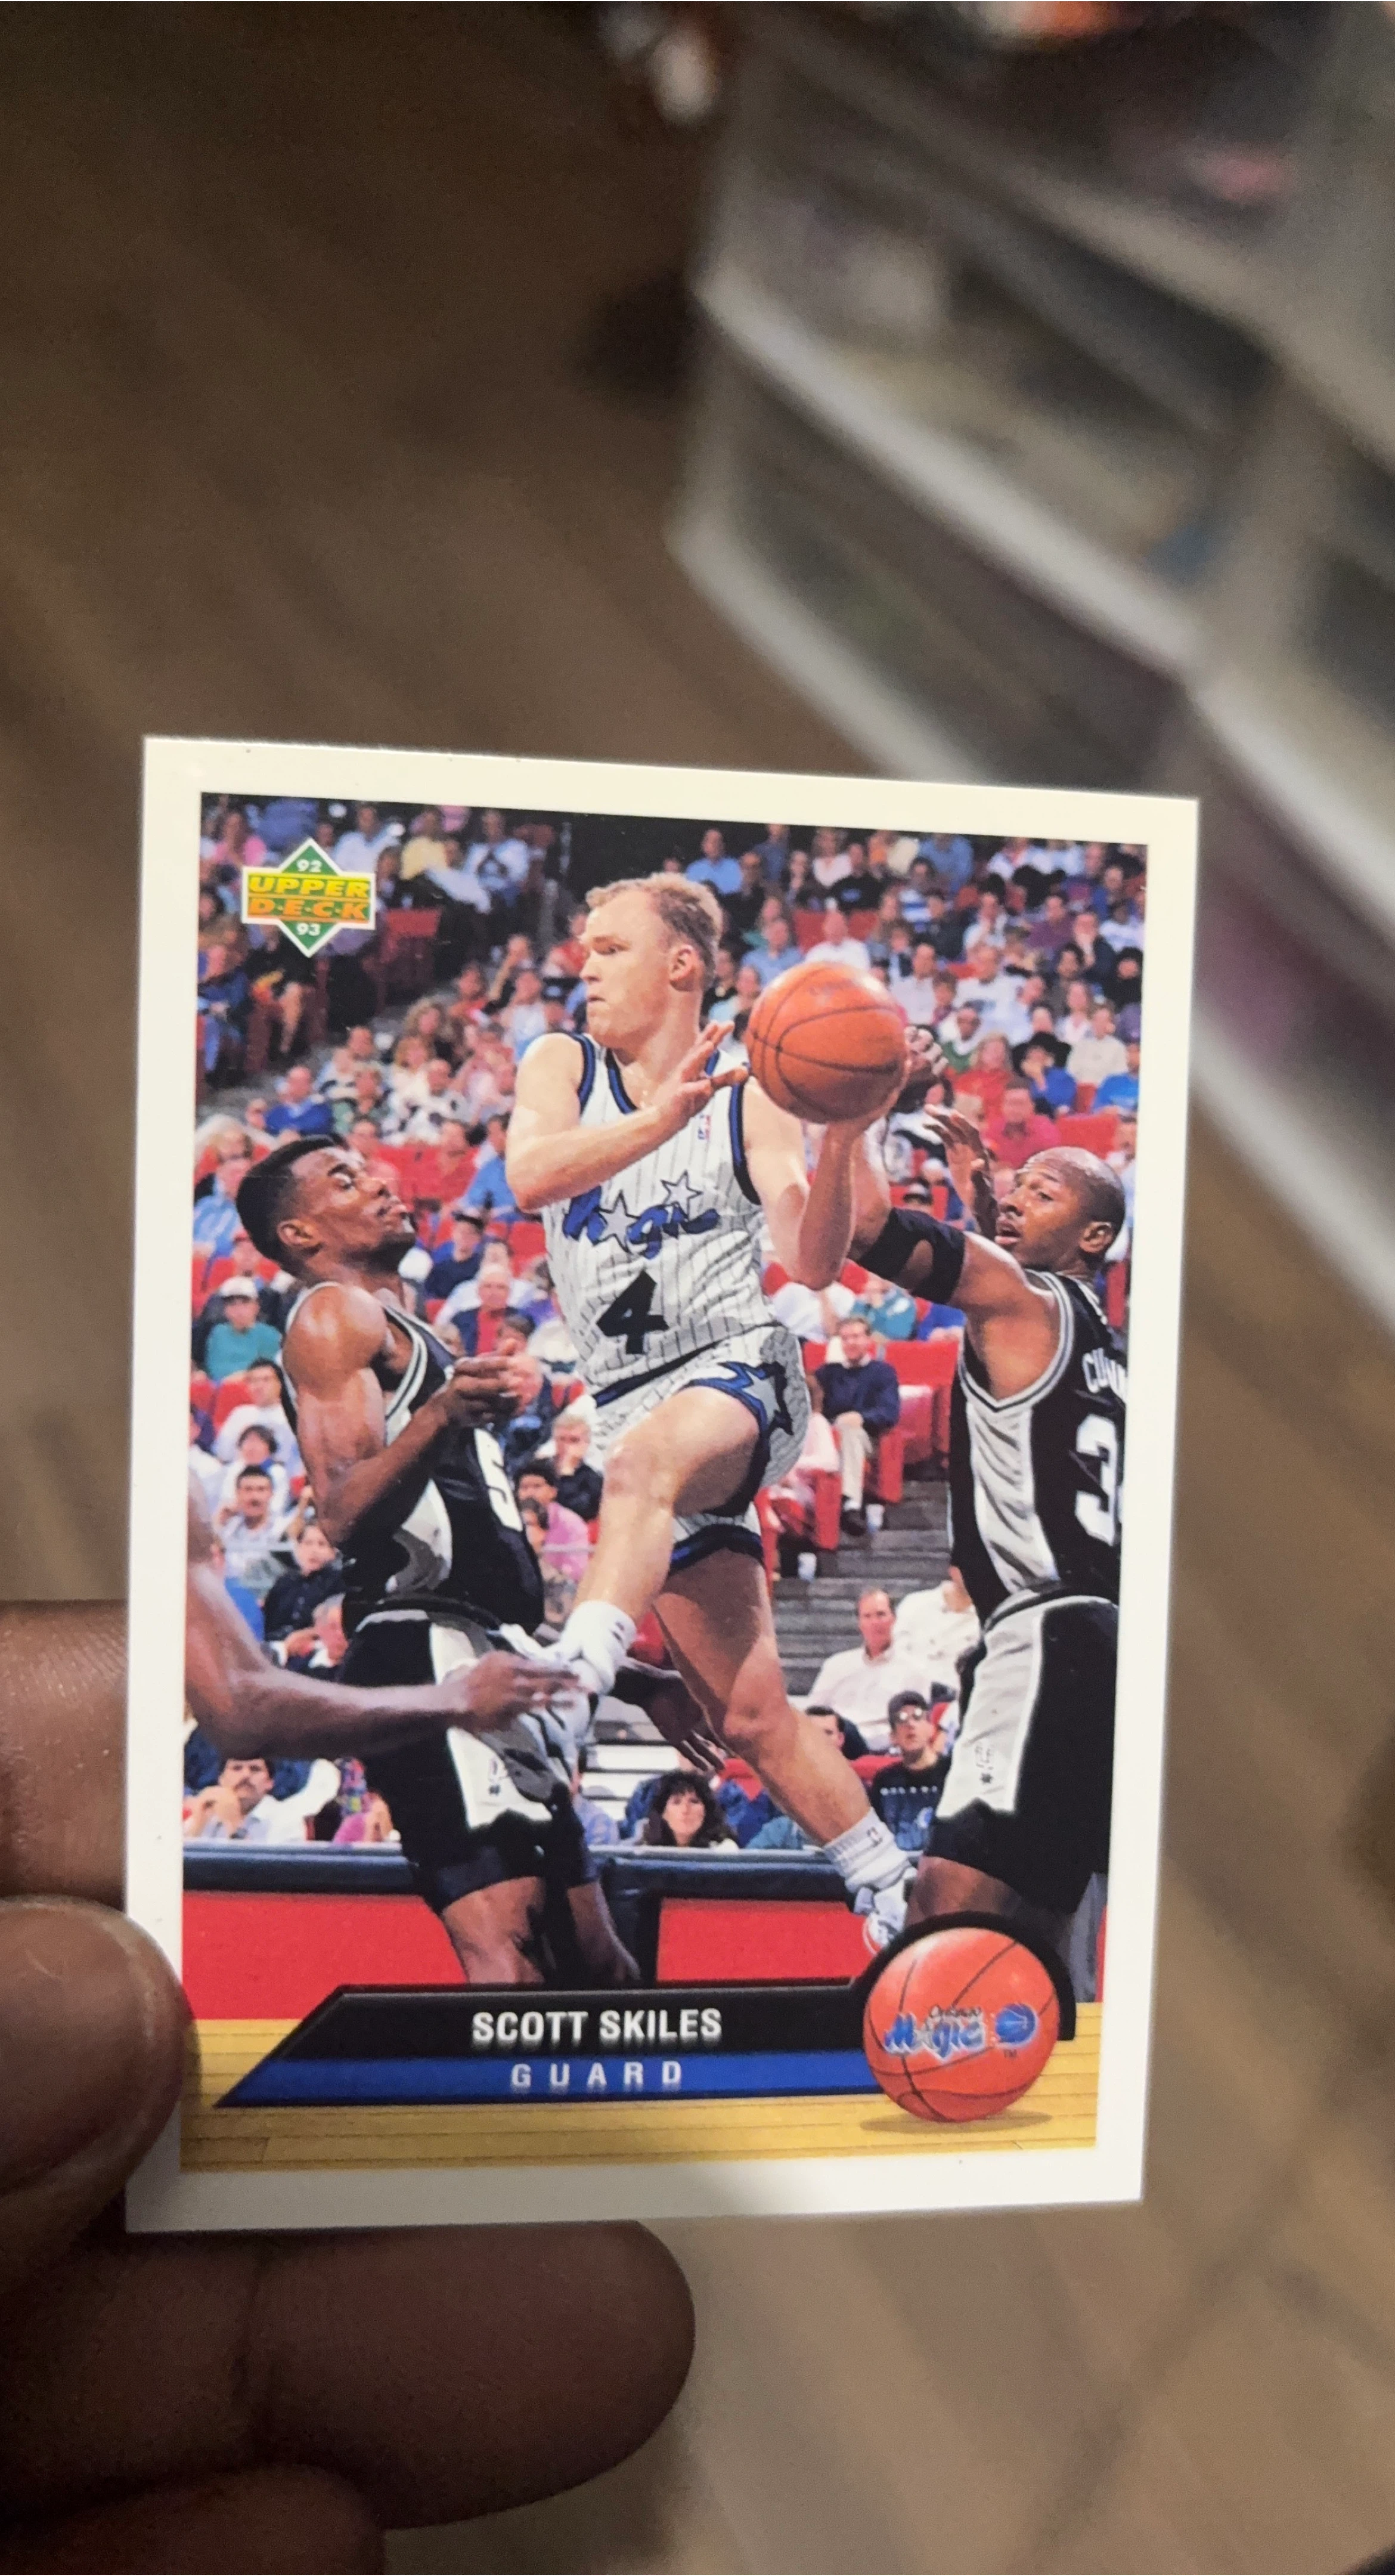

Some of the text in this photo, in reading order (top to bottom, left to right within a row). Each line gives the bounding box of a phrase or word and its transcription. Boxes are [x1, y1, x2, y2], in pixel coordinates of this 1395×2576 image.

[296, 859, 323, 873] 92
[249, 876, 370, 898] UPPER
[296, 922, 321, 936] 93
[596, 1270, 669, 1355] 4
[1075, 1414, 1123, 1547] 3
[472, 2008, 723, 2042] SCOTT SKILES
[511, 2061, 682, 2088] GUARD
